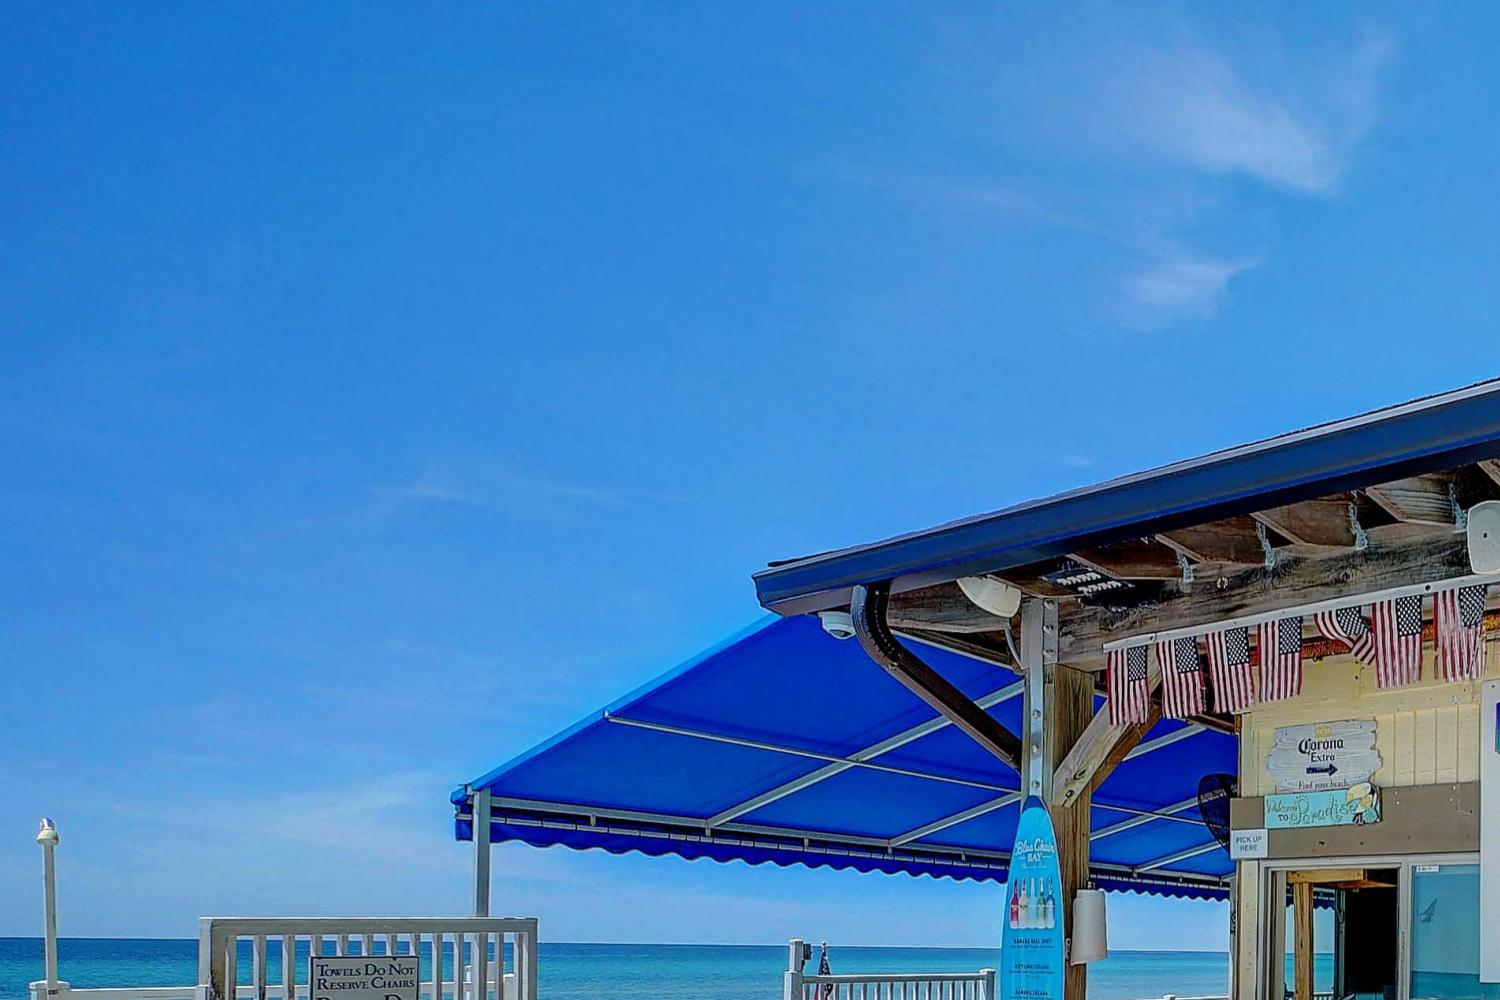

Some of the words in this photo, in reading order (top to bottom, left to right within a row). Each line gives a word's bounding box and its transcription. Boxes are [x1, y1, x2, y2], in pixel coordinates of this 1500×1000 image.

[1298, 738, 1344, 756] Corona
[1310, 752, 1335, 762] Extra
[1235, 836, 1251, 844] PICK
[1252, 835, 1262, 843] UP
[1015, 840, 1034, 855] Blue
[1240, 844, 1258, 852] HERE
[1027, 853, 1043, 862] BAY
[316, 964, 361, 977] TOWELS
[389, 963, 415, 976] NOT
[317, 978, 369, 990] RESERVE
[371, 977, 415, 989] CHAIRS
